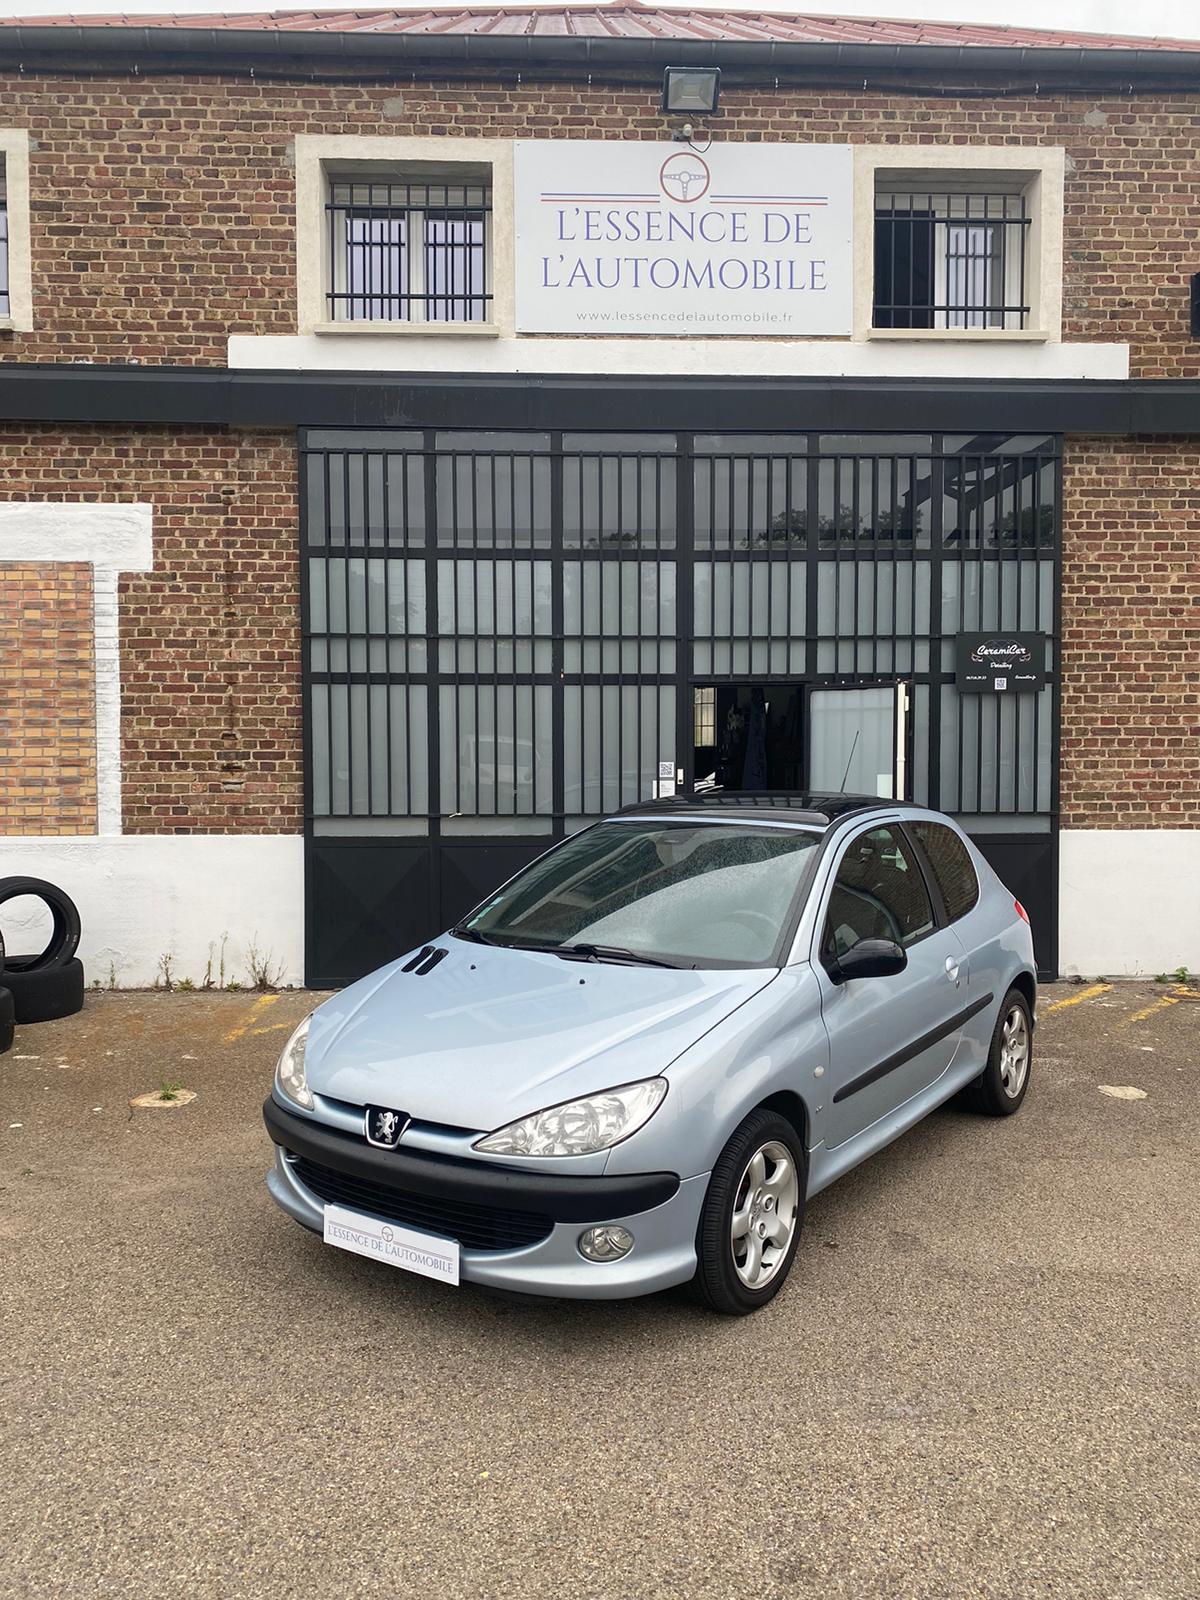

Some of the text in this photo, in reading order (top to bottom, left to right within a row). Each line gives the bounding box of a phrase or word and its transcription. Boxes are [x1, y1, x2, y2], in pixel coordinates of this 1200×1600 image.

[557, 208, 812, 244] L'ESSENCE DE
[542, 254, 827, 291] L'AUTOMOBILE
[576, 310, 794, 323] www.lessencedelautomobile.fr
[976, 644, 1026, 655] CeramiCar
[328, 1224, 369, 1247] L'ESSENCE
[371, 1238, 383, 1252] DE
[385, 1242, 453, 1274] L'AUTOMOBILE
